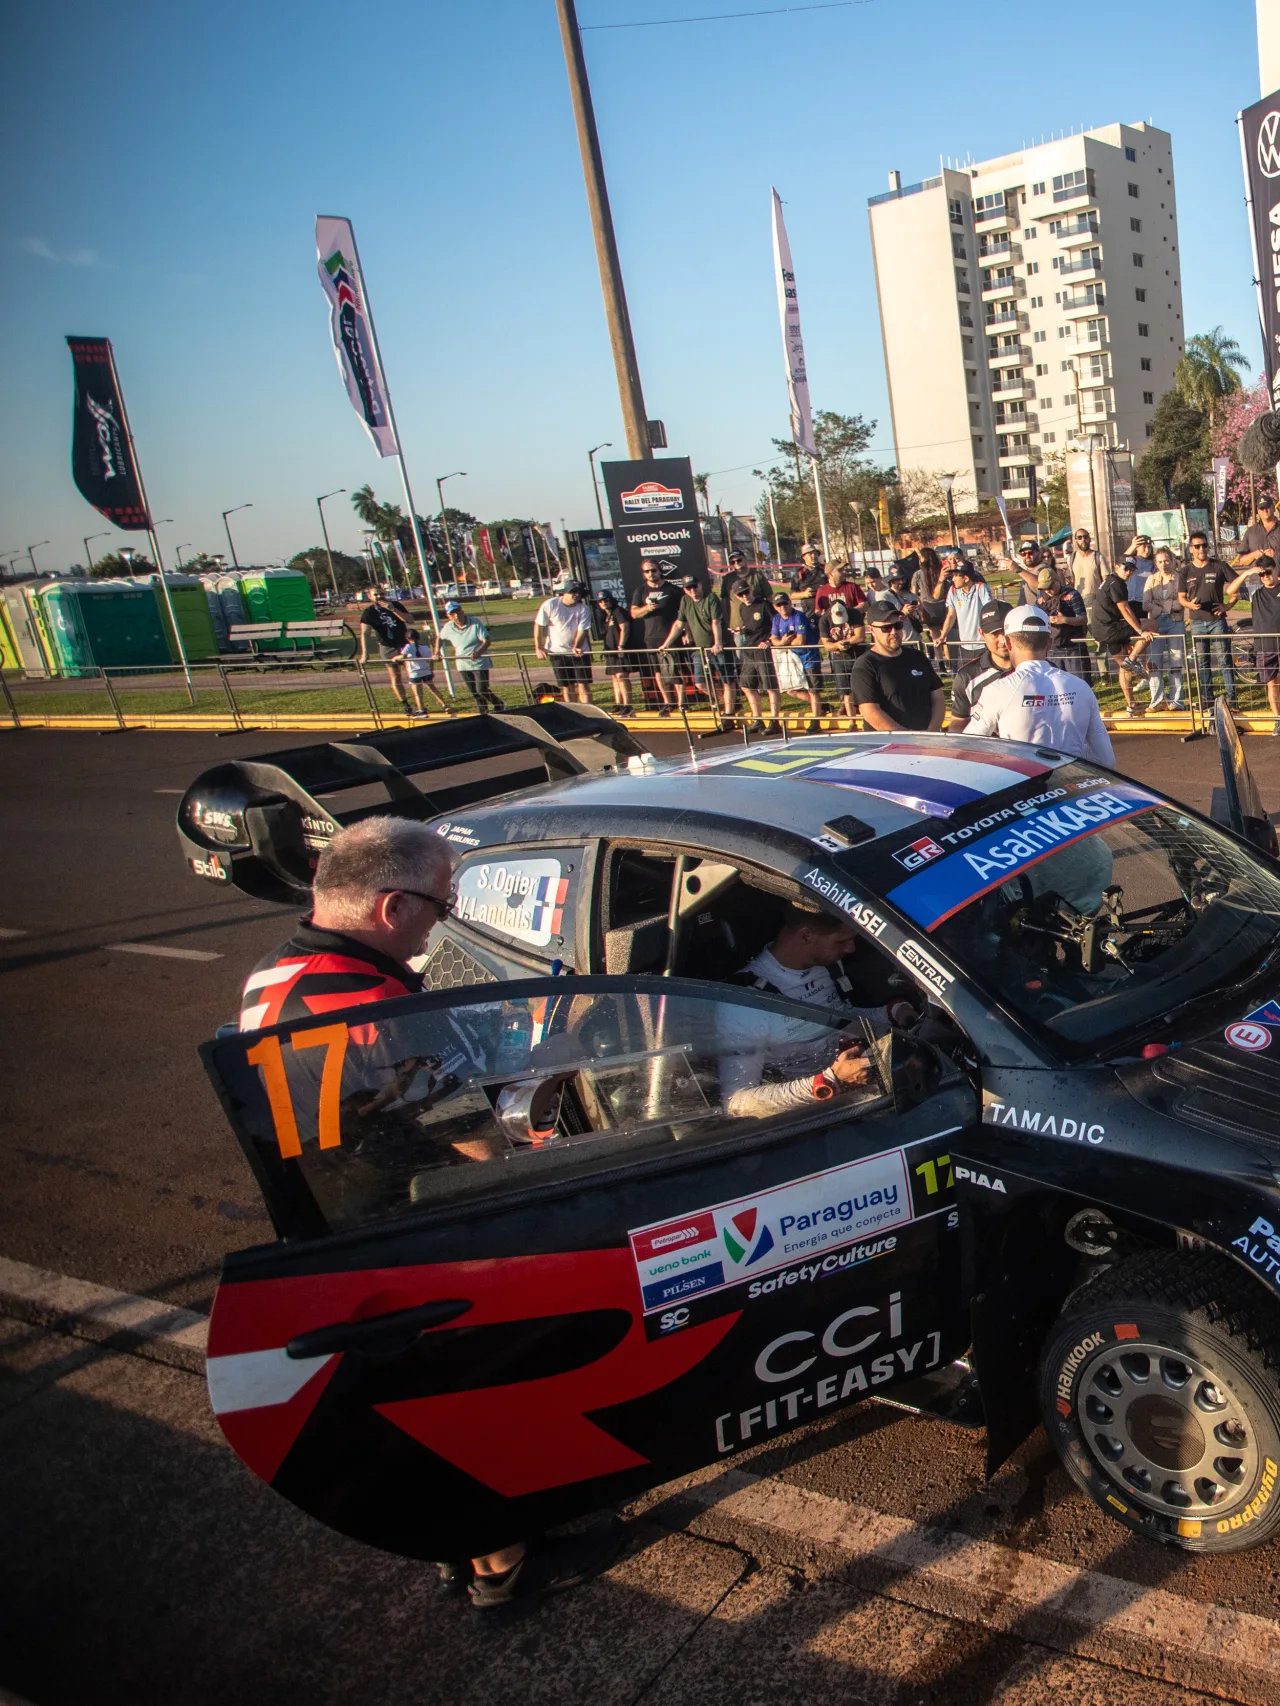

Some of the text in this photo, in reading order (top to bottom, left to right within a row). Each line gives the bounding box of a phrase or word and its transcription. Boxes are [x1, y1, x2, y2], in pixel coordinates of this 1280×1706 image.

[651, 495, 681, 503] PARAGUAY
[626, 532, 659, 543] ueno
[659, 528, 691, 540] bank
[940, 775, 1111, 845] TOYOTA GAZOO Racing
[446, 834, 481, 847] AIRLINES
[450, 825, 474, 836] JAPAN
[963, 788, 1131, 881] AsahiKASEI
[192, 854, 227, 880] Stilo
[902, 843, 942, 869] GR
[804, 867, 888, 938] AsahiKASEI
[899, 941, 947, 992] CENTRAL
[247, 1022, 350, 1160] 17
[990, 1102, 1106, 1145] TAMADIC
[955, 1165, 1008, 1194] PIAA
[779, 1183, 899, 1237] Paraguay
[653, 1232, 682, 1247] Petropar
[783, 1207, 901, 1254] Energía que conecta
[649, 1248, 712, 1277] ueno bank
[748, 1235, 898, 1299] SafetyCulture
[662, 1276, 706, 1299] PILSEN
[659, 1307, 690, 1330] SC
